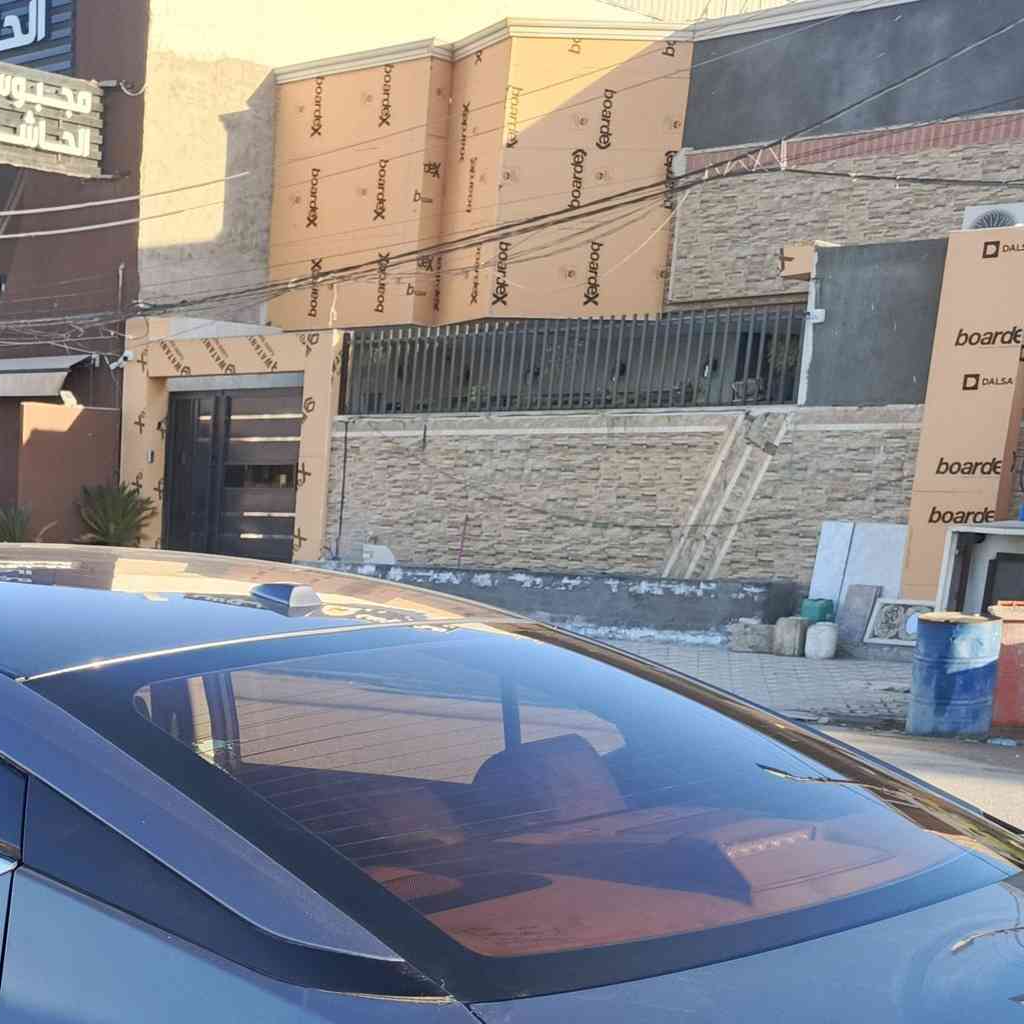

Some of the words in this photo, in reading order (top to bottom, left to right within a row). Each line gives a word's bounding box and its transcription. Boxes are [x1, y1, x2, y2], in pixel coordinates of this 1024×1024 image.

[309, 75, 324, 137] boardeX
[378, 64, 394, 128] boardeX
[305, 168, 320, 228] boardeX
[373, 159, 389, 221] boardeX
[491, 241, 511, 306] boardeX
[583, 241, 603, 306] boardeX
[982, 376, 1014, 386] DALSA
